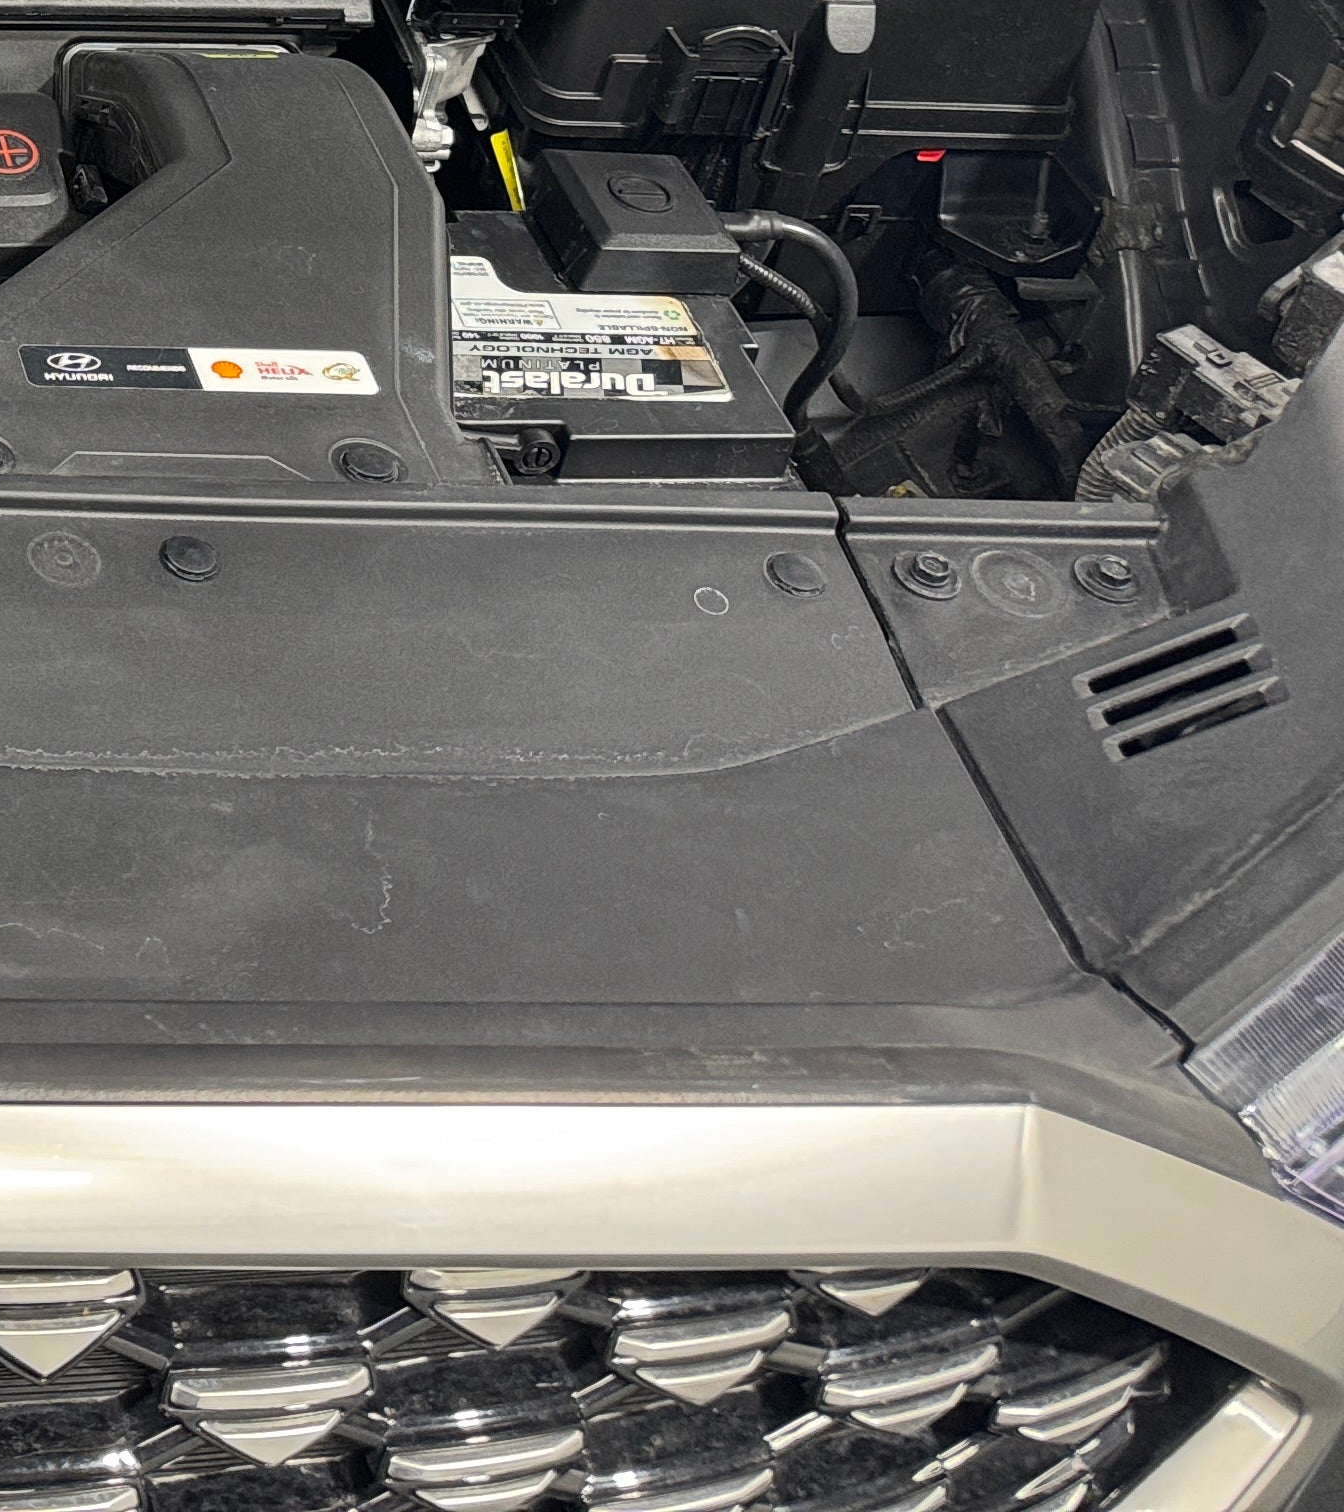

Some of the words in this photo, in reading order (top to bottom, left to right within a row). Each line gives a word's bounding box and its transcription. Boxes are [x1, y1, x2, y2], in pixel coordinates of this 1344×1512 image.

[598, 323, 689, 333] NON-SPILLABLE
[468, 343, 601, 356] TECHNOLOGY
[607, 346, 654, 357] AGM
[480, 357, 601, 371] PLATINUM
[257, 365, 312, 376] HELIX
[43, 372, 114, 382] HYUNDAI
[482, 370, 669, 397] Duralast
